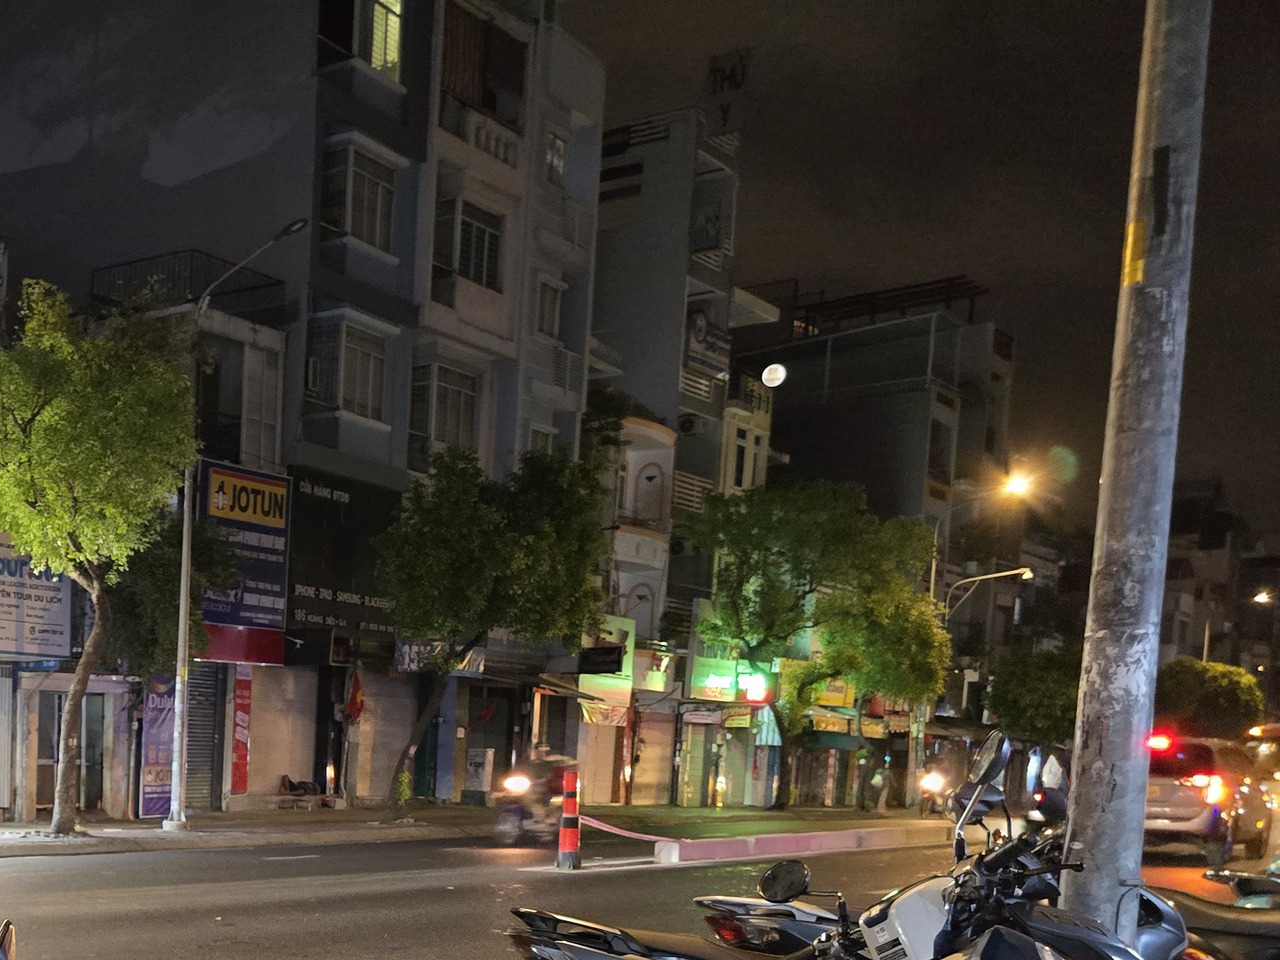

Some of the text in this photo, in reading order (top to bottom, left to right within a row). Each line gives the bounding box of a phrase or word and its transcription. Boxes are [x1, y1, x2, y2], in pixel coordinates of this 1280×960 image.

[229, 483, 285, 519] JOTUN
[13, 591, 33, 601] TOUR
[34, 595, 45, 603] DU
[45, 595, 63, 606] LỊCH
[149, 693, 176, 708] Dulu
